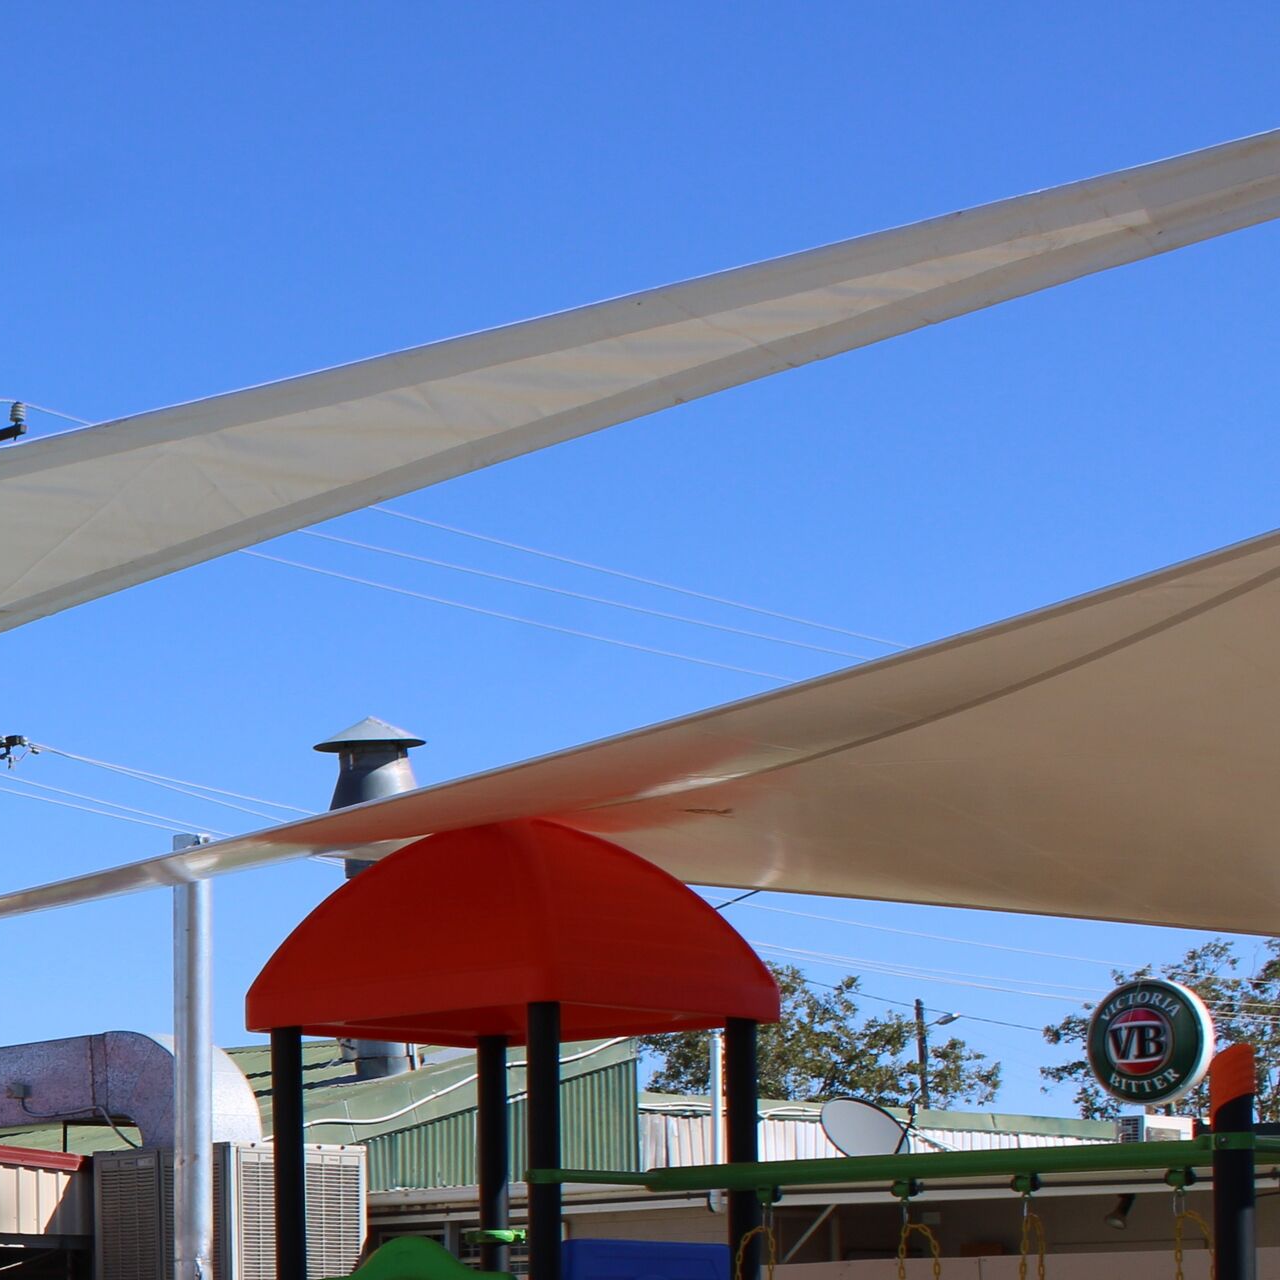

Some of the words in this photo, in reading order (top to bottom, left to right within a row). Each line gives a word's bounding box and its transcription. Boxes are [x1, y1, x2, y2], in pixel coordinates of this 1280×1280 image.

[1101, 991, 1181, 1021] VICTORIA
[1109, 1026, 1164, 1060] VB
[1110, 1068, 1180, 1093] BITTER
